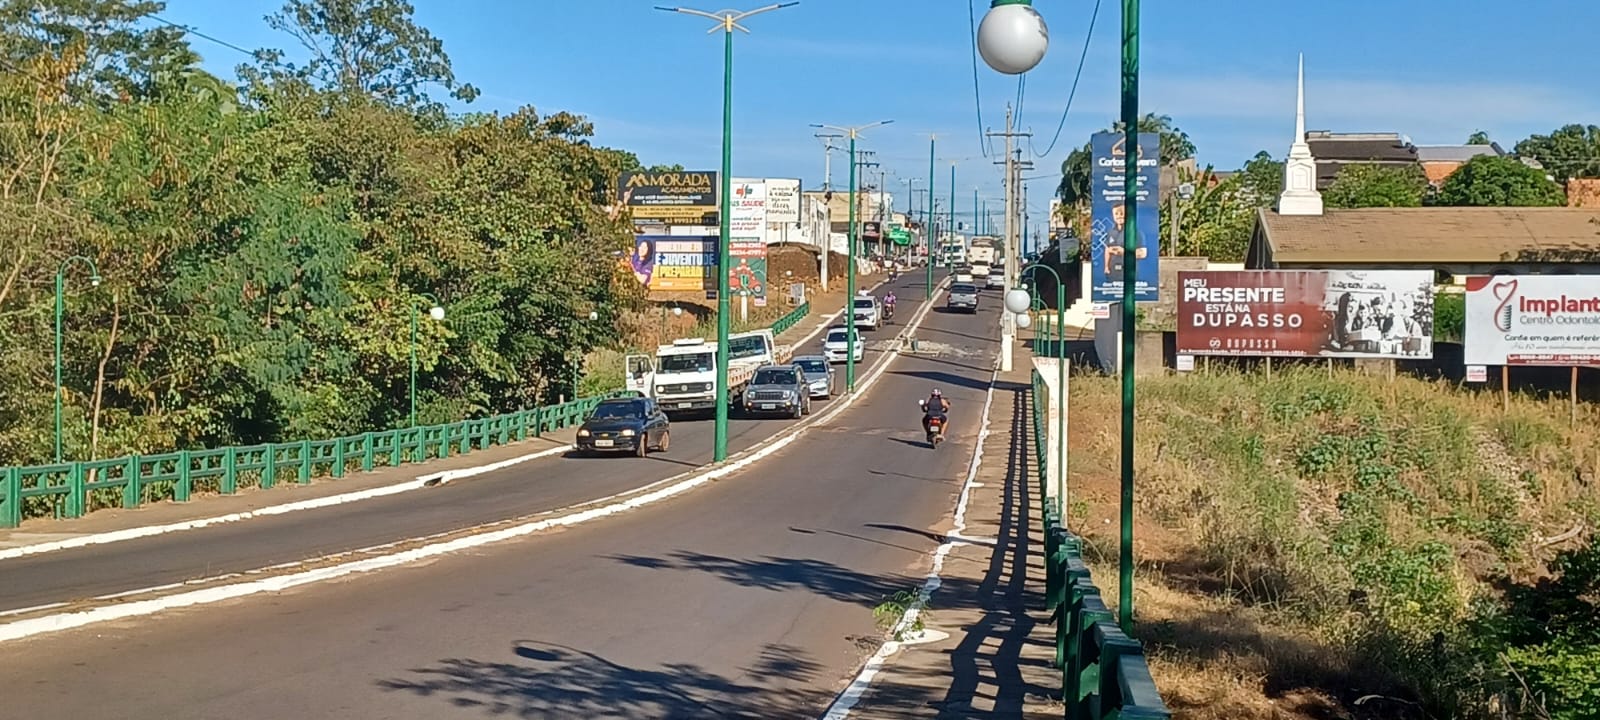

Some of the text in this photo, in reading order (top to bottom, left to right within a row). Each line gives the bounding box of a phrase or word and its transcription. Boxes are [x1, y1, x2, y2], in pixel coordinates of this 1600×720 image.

[650, 173, 711, 186] MORADA
[1184, 279, 1207, 287] MEU
[1184, 287, 1284, 302] PRESENTE
[1205, 302, 1250, 313] ESTÁ NA
[1193, 313, 1302, 327] DUPASSO
[1520, 315, 1554, 325] Centro
[1504, 334, 1528, 342] Confie
